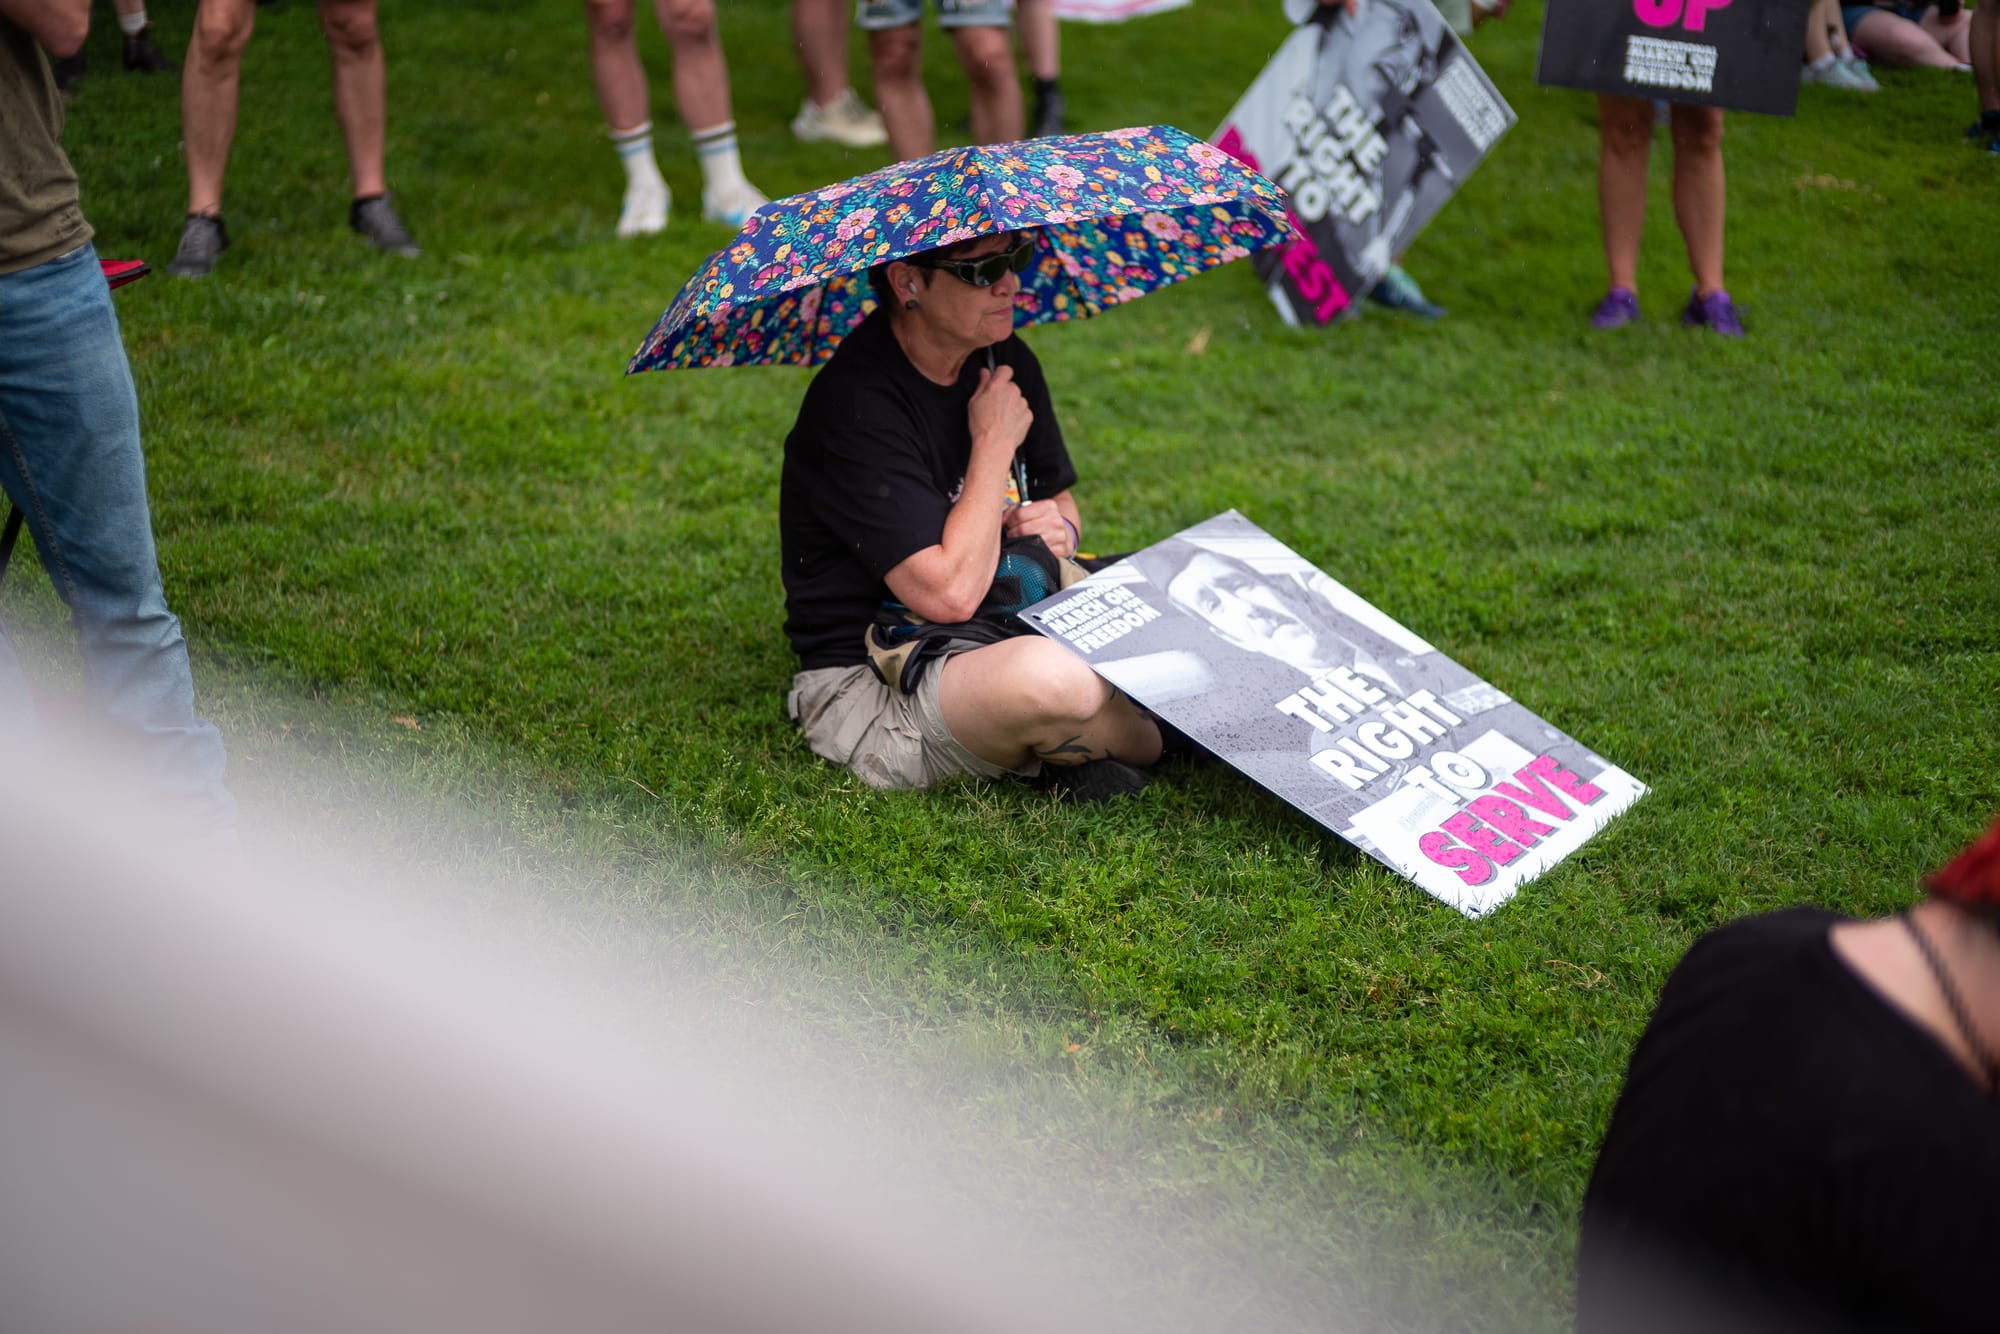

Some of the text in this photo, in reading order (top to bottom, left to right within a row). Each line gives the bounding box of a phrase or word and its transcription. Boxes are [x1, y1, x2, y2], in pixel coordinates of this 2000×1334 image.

[1623, 64, 1713, 93] FREEDOM
[1626, 43, 1687, 65] MARCH
[1688, 51, 1717, 69] ON
[1324, 83, 1389, 176] THE
[1282, 95, 1381, 226] RIGHT
[1047, 585, 1135, 635] MARCH ON
[1062, 596, 1146, 641] WASHINGTON FOR
[1072, 607, 1162, 654] FREEDOM
[1275, 665, 1387, 733] THE
[1308, 688, 1463, 791] RIGHT
[1402, 751, 1488, 804] TO
[1419, 753, 1606, 887] SERVE
